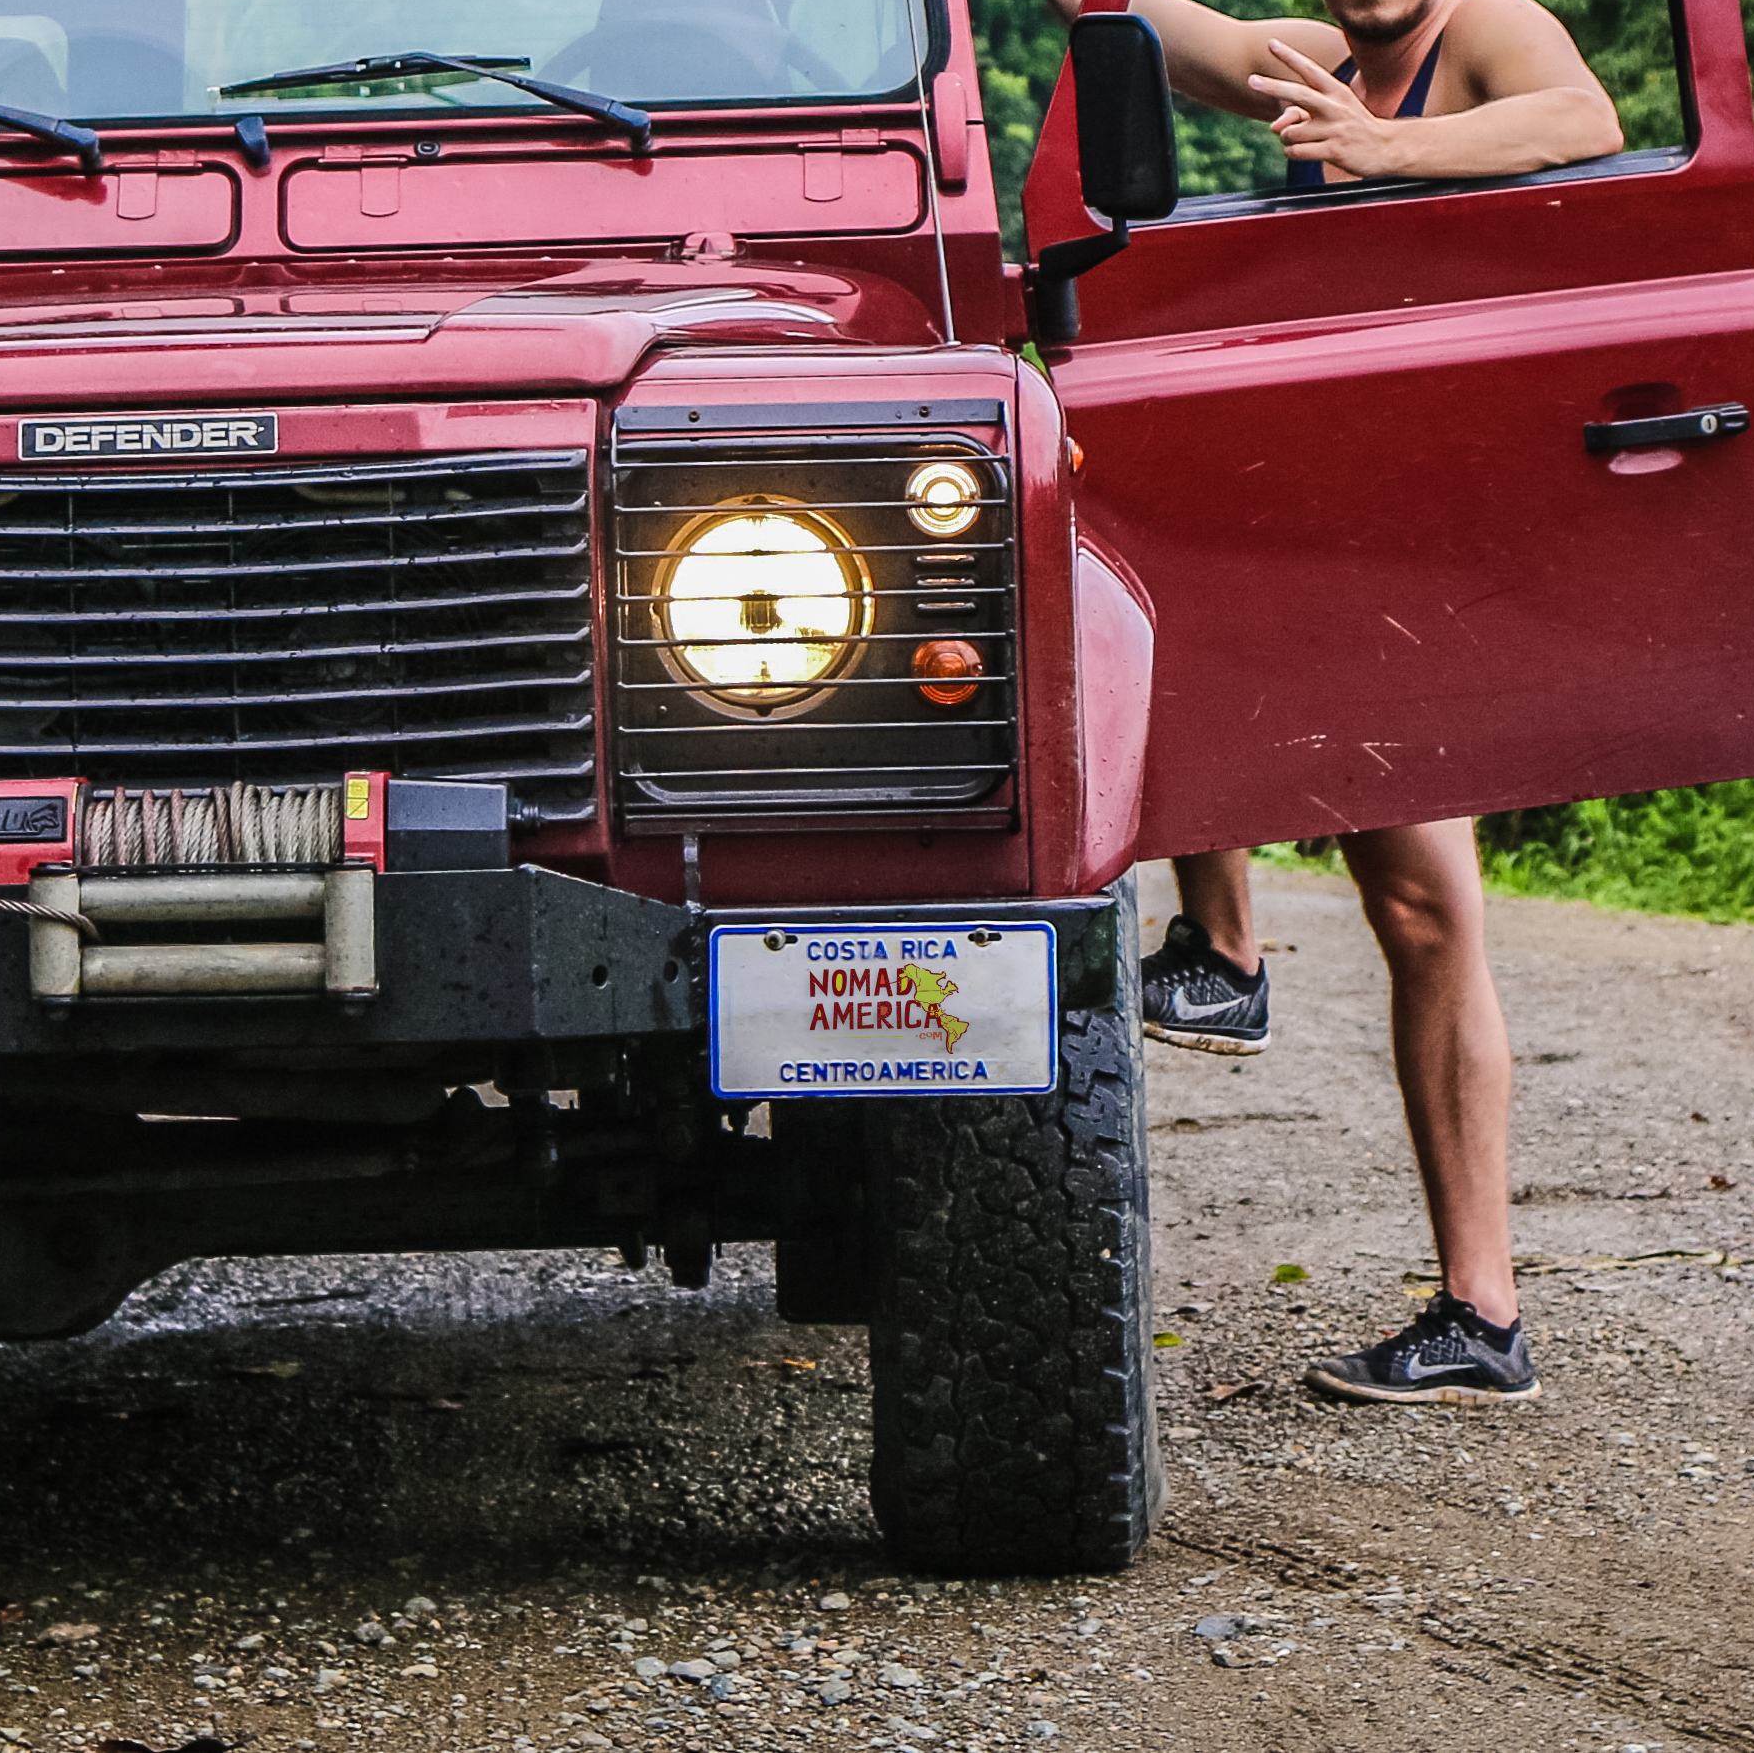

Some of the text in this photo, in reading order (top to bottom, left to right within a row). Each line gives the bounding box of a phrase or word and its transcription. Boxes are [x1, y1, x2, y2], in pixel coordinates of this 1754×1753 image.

[34, 420, 259, 453] DEFENDER
[807, 939, 958, 961] COSTA RICA
[809, 967, 913, 998] NOMAD
[809, 999, 943, 1031] AMERICA
[779, 1058, 990, 1083] CENTROAMERICA
